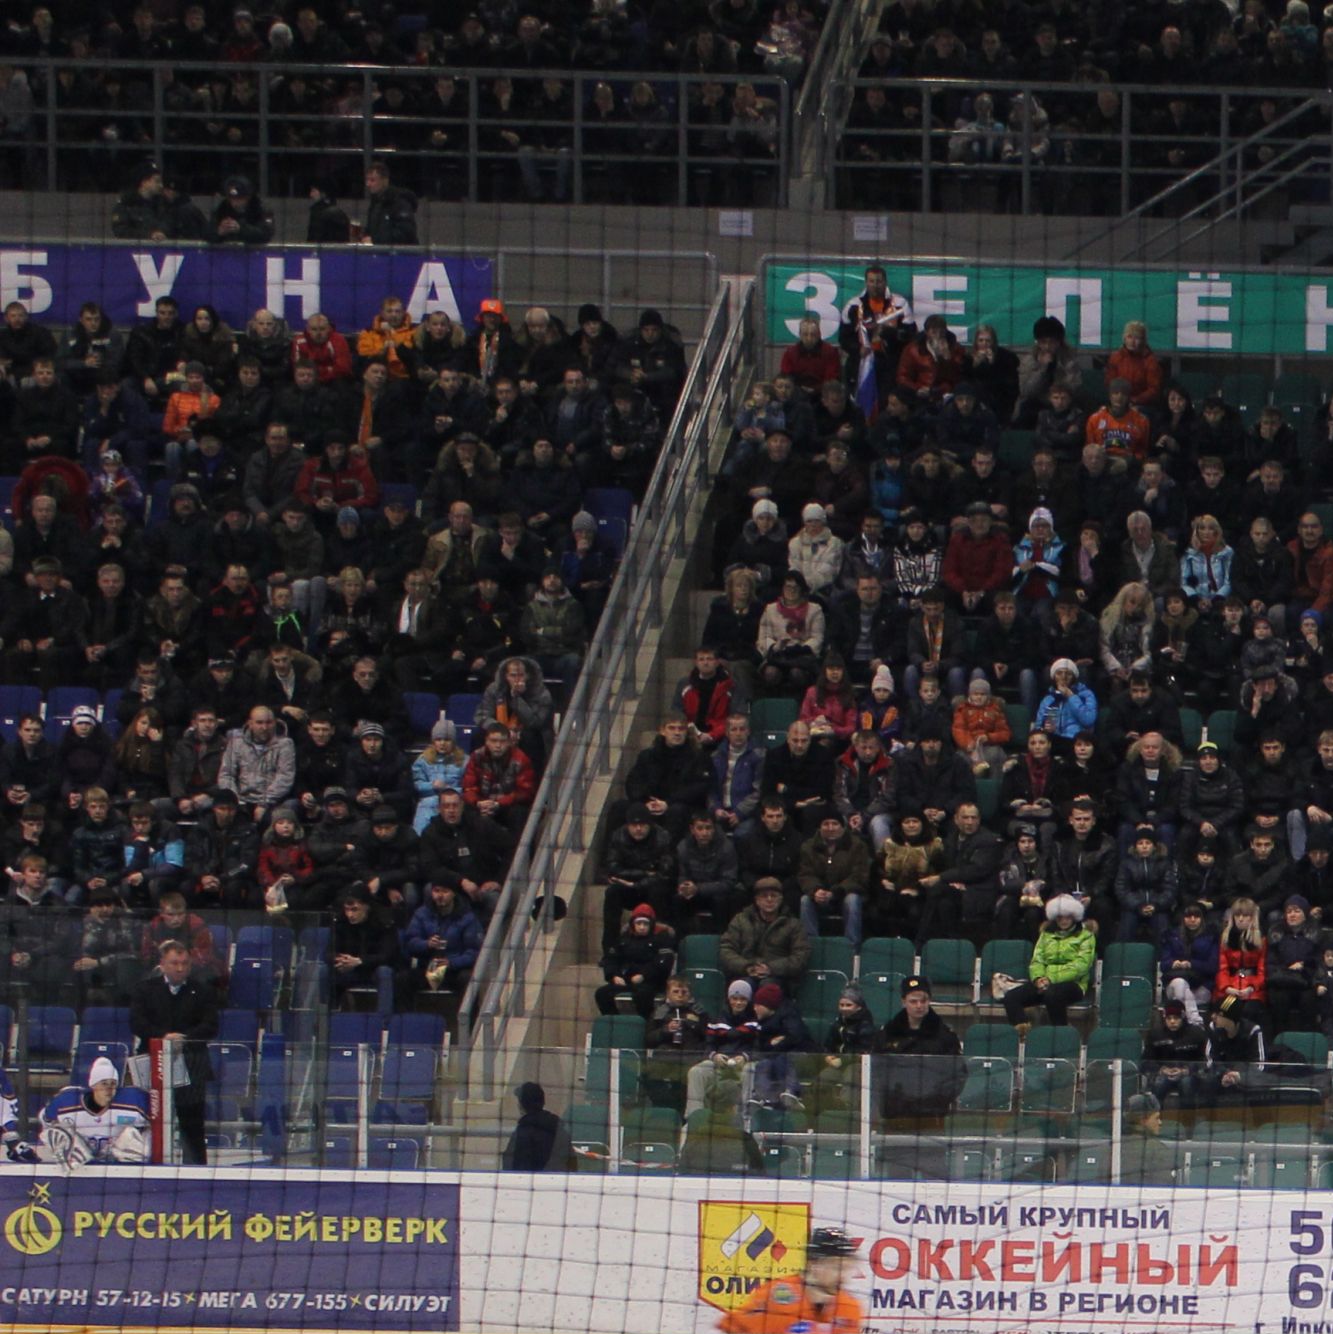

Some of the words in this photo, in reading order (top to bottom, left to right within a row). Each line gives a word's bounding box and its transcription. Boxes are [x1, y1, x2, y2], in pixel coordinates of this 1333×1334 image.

[73, 1209, 232, 1241] РУССКИЙ
[244, 1210, 449, 1244] ФЕЙЕРВЕРК
[892, 1203, 1007, 1228] САМЫЙ
[1019, 1204, 1170, 1230] КРУПНЫЙ
[706, 1276, 770, 1295] ОЛИ
[1, 1287, 88, 1307] САТУРН
[97, 1290, 181, 1308] 57-12-15
[199, 1291, 257, 1310] МЕГА
[265, 1293, 348, 1312] 677-155
[365, 1294, 451, 1313] СИЛУЭТ
[872, 1288, 1017, 1313] МАГАЗИН
[1029, 1292, 1046, 1313] В
[1059, 1293, 1199, 1316] РЕГИОНЕ
